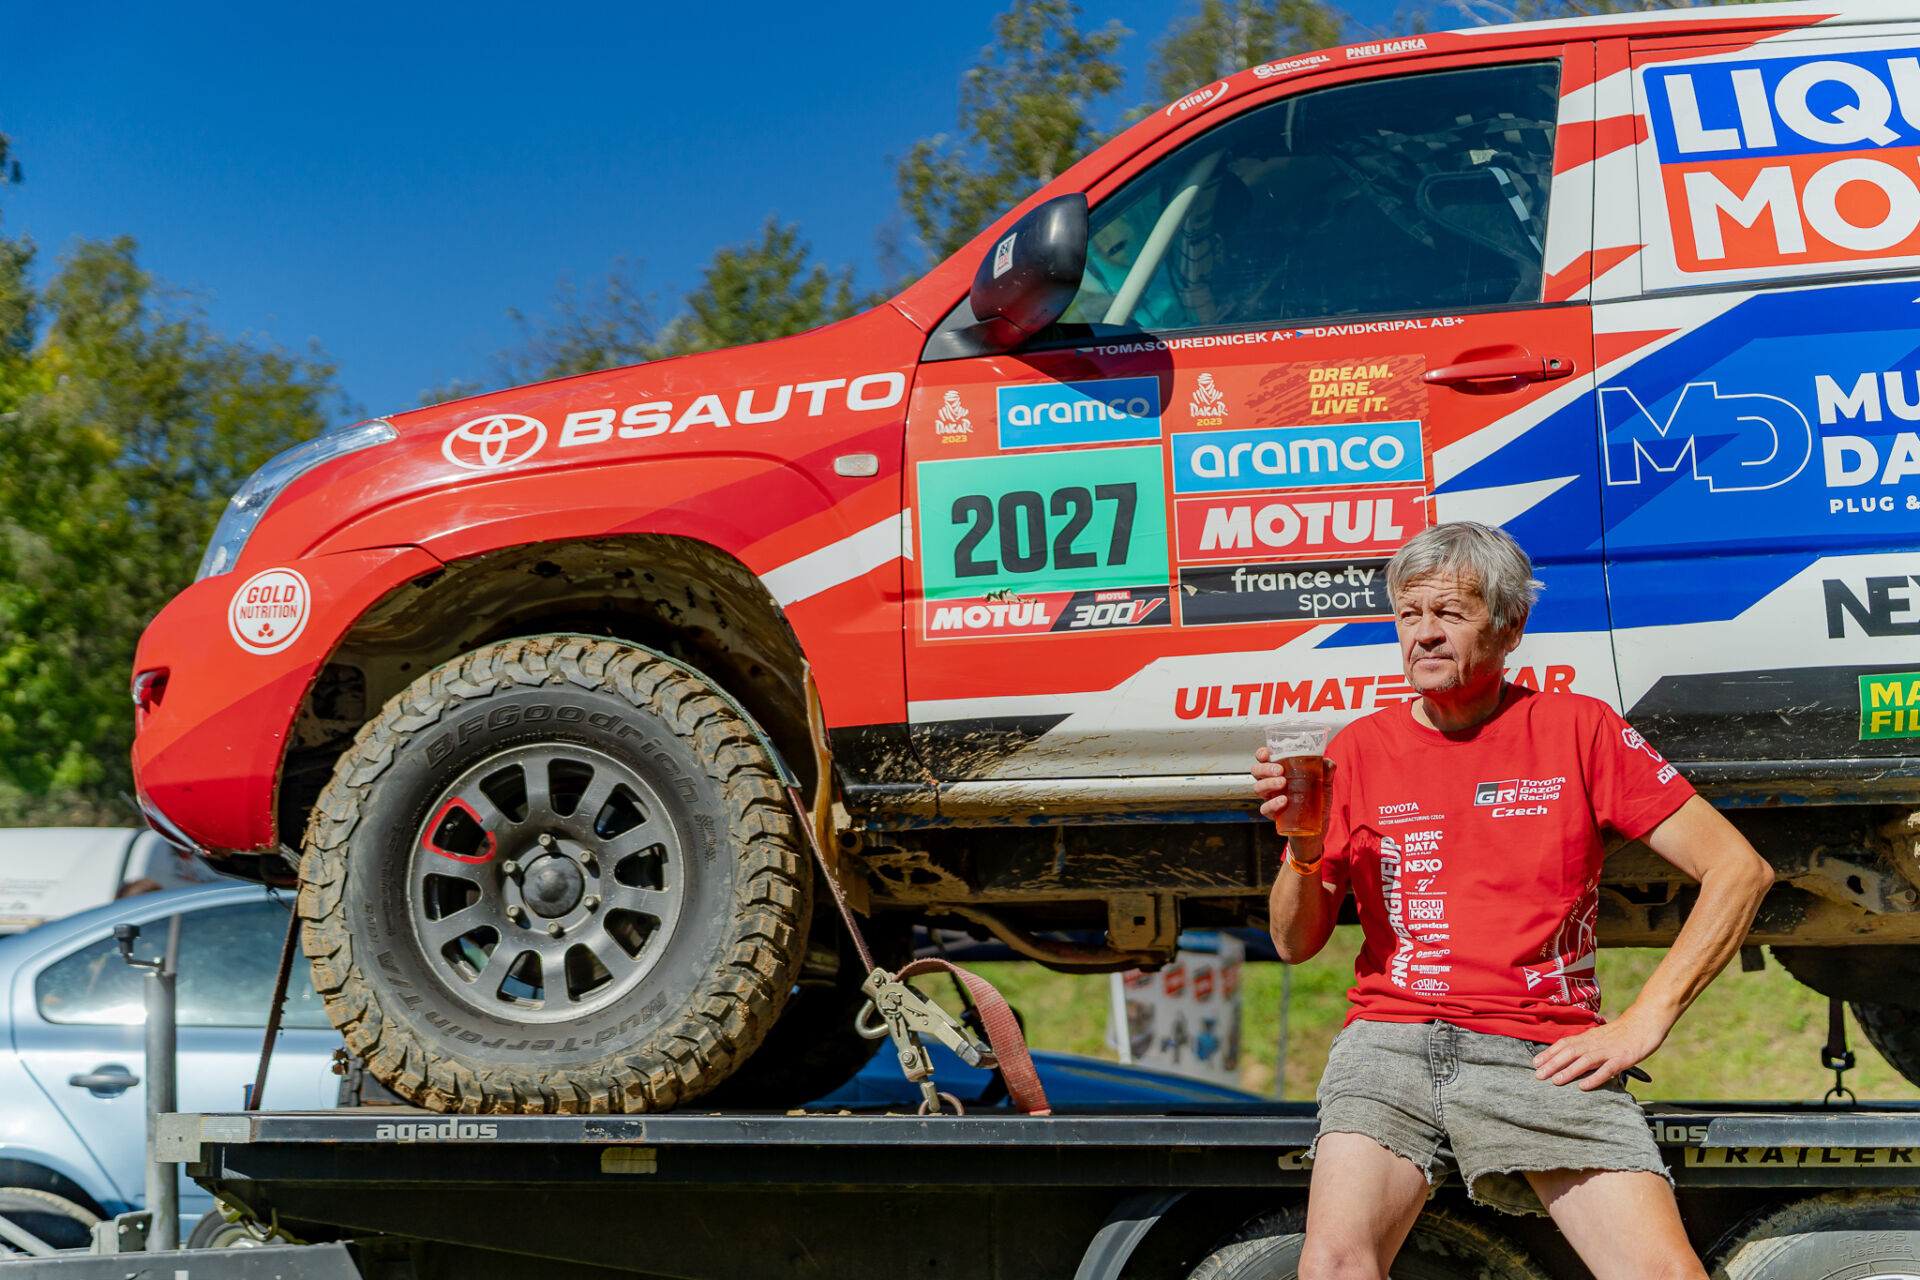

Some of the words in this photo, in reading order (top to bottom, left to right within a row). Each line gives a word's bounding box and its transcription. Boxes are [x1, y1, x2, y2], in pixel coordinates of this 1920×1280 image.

[1346, 44, 1380, 58] PNEU
[1383, 38, 1427, 53] KAFKA
[1683, 156, 1920, 261] MO
[1314, 320, 1427, 338] DAVIDKRIPAL
[1430, 317, 1465, 328] AB+
[1096, 332, 1268, 356] TOMASOUREDNICEK
[1271, 331, 1293, 342] A+
[1308, 365, 1394, 383] DREAM.
[1309, 381, 1375, 399] DARE.
[558, 371, 906, 448] BSAUTO
[1008, 397, 1150, 427] aramco
[1189, 401, 1229, 418] DAKAR
[1310, 399, 1359, 416] LIVE
[1363, 397, 1389, 413] IT.
[935, 419, 974, 436] DAKAR
[1196, 418, 1223, 427] 2023
[941, 435, 968, 444] 2023
[1190, 435, 1404, 479] aramco
[1829, 496, 1894, 514] PLUG
[951, 482, 1138, 579] 2027
[1199, 499, 1404, 550] MOTUL
[246, 585, 296, 604] GOLD
[1097, 591, 1129, 601] MOTUL
[1299, 587, 1376, 617] sport
[240, 605, 297, 619] NUTRITION
[930, 602, 1051, 631] MOTUL
[1070, 597, 1166, 628] 300V
[425, 703, 700, 804] BFGoodrich
[1519, 785, 1562, 794] GAZOO
[1521, 777, 1566, 787] TOYOTA
[1477, 788, 1516, 804] GR
[1519, 792, 1560, 802] Racing
[1378, 802, 1419, 815] TOYOTA
[1491, 805, 1548, 818] Czech
[1405, 830, 1443, 843] MUSIC
[1405, 841, 1439, 853] DATA
[1405, 858, 1443, 873] NEXO
[1411, 900, 1441, 909] LIQUI
[1410, 910, 1443, 920] MOLY
[1408, 922, 1449, 930] agados
[375, 1118, 498, 1143] agados
